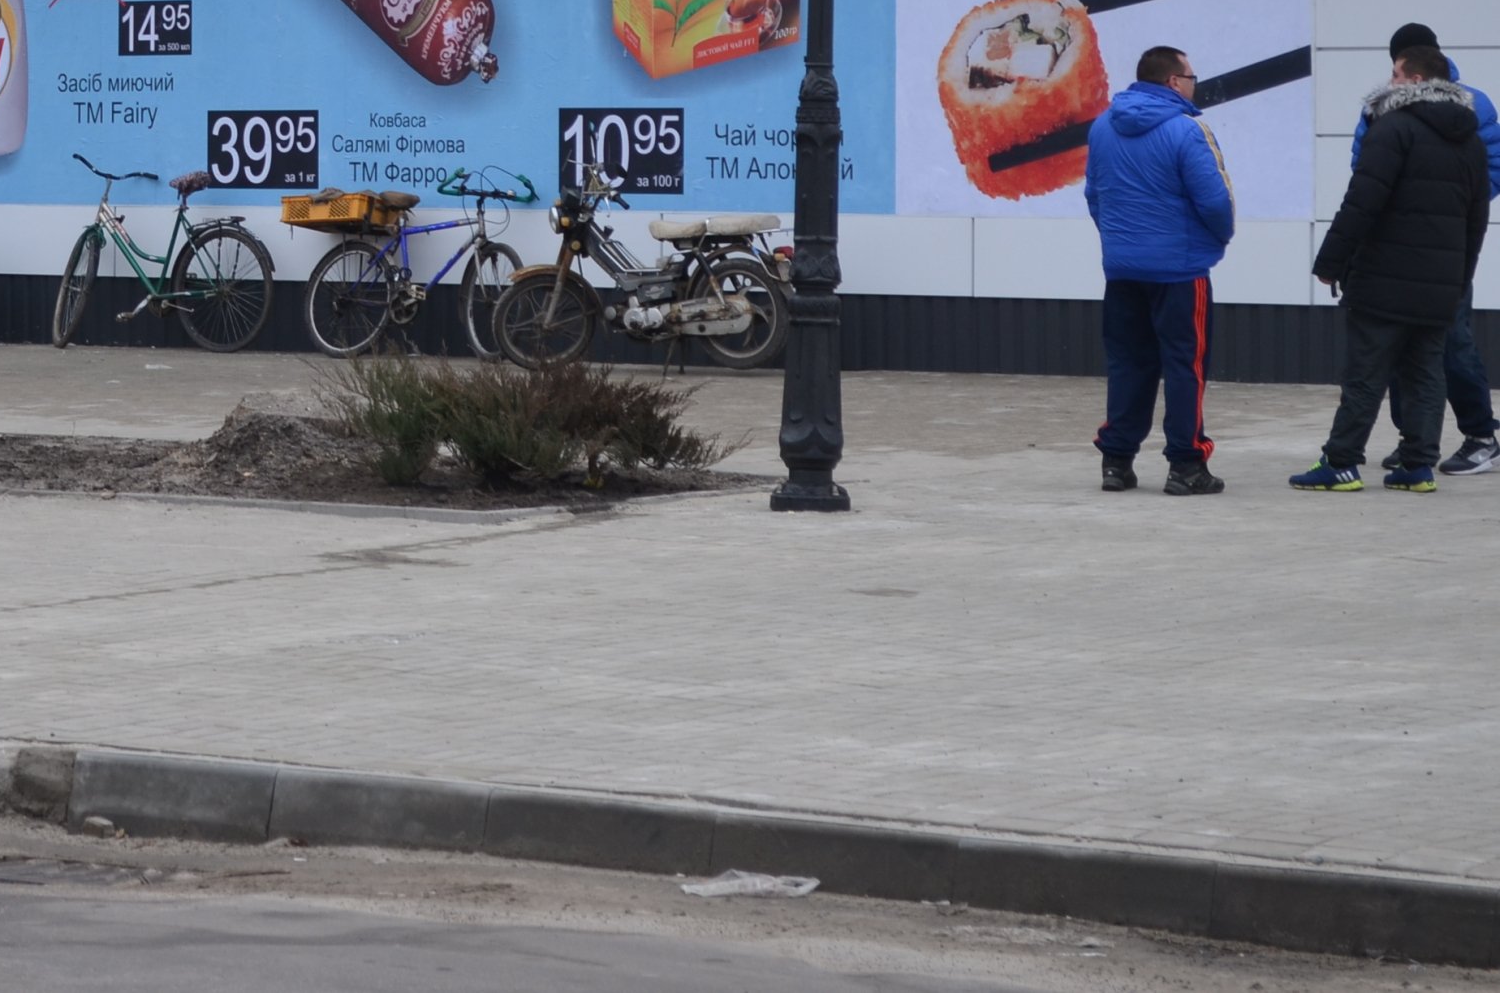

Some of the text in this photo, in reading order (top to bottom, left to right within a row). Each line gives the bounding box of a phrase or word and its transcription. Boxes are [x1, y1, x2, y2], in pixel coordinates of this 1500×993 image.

[57, 73, 175, 93] Засіб миючий
[110, 102, 158, 129] Fairy
[369, 112, 427, 128] Ковбаса
[331, 134, 466, 157] Салямі Фірмова
[714, 123, 757, 147] Чай
[284, 174, 296, 183] за
[384, 161, 448, 188] Фарро
[636, 176, 650, 188] за
[652, 174, 672, 188] 100
